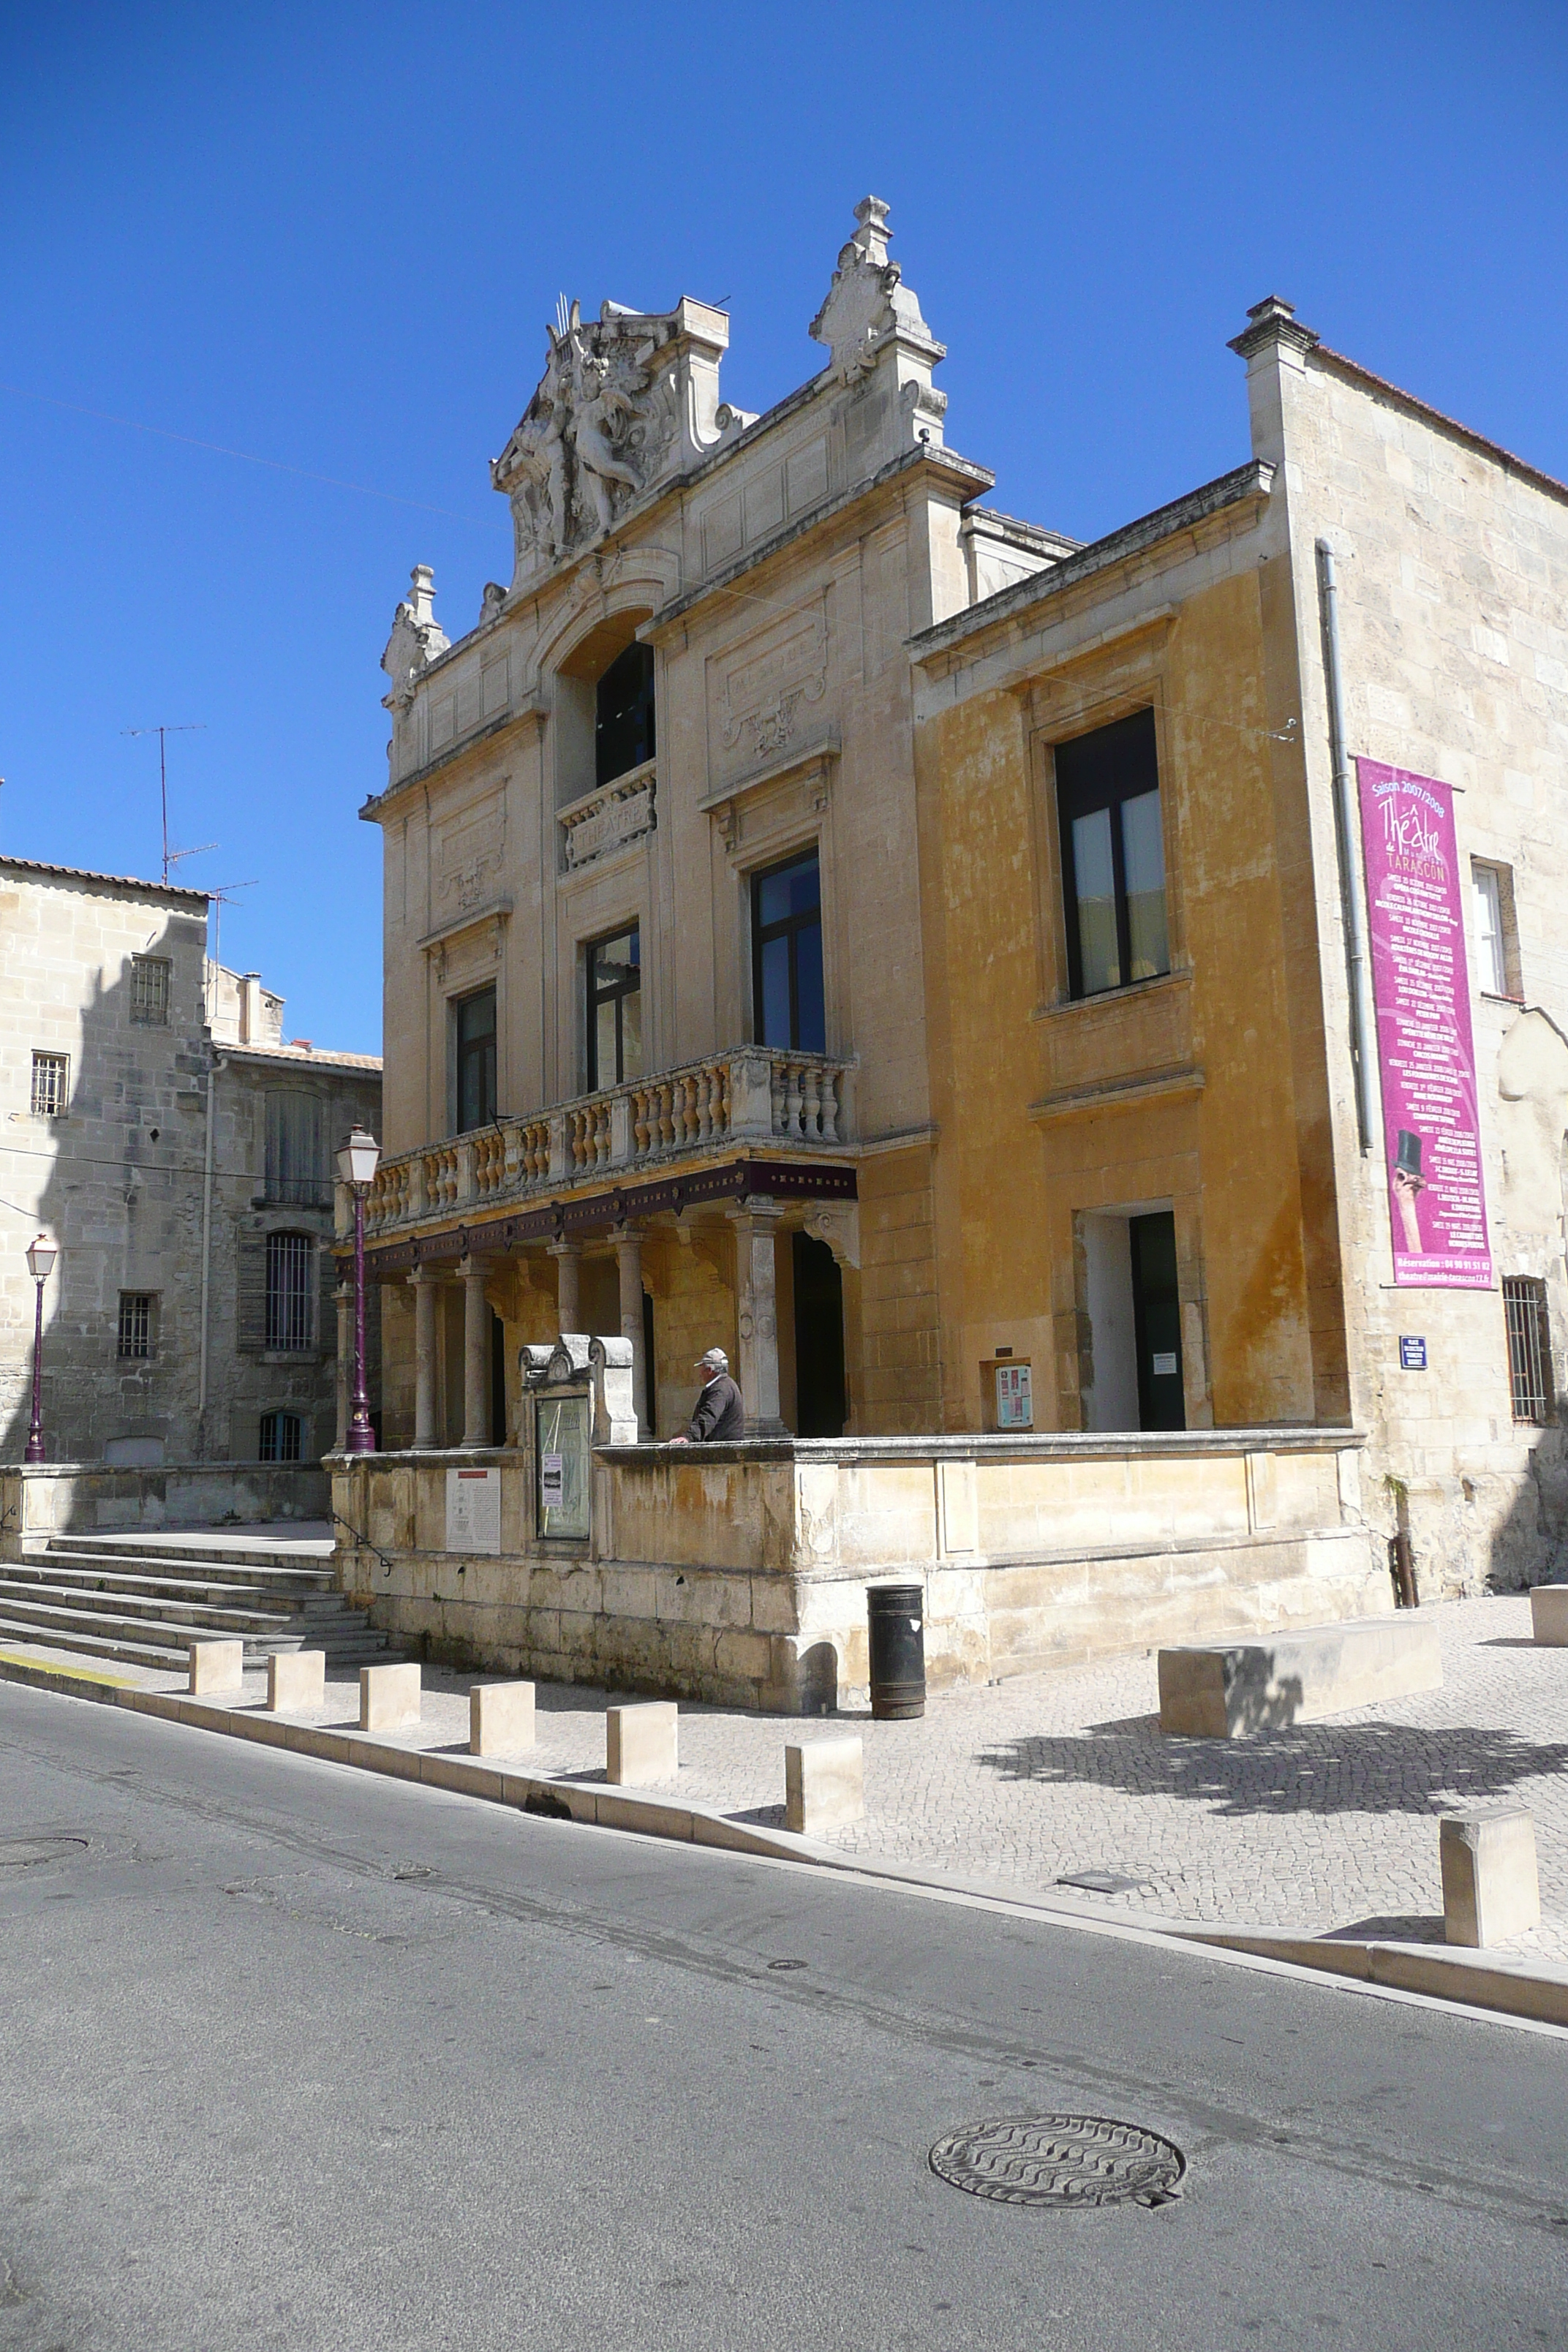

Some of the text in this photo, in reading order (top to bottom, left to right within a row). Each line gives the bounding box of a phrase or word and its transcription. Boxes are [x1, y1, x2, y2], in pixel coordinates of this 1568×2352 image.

[1372, 780, 1445, 818] Saison 2007/2008
[1378, 795, 1442, 862] Théâtre
[1386, 842, 1396, 852] de
[1386, 852, 1445, 882] TARASCON
[1398, 1257, 1440, 1268] Réservation
[1444, 1259, 1453, 1270] 04
